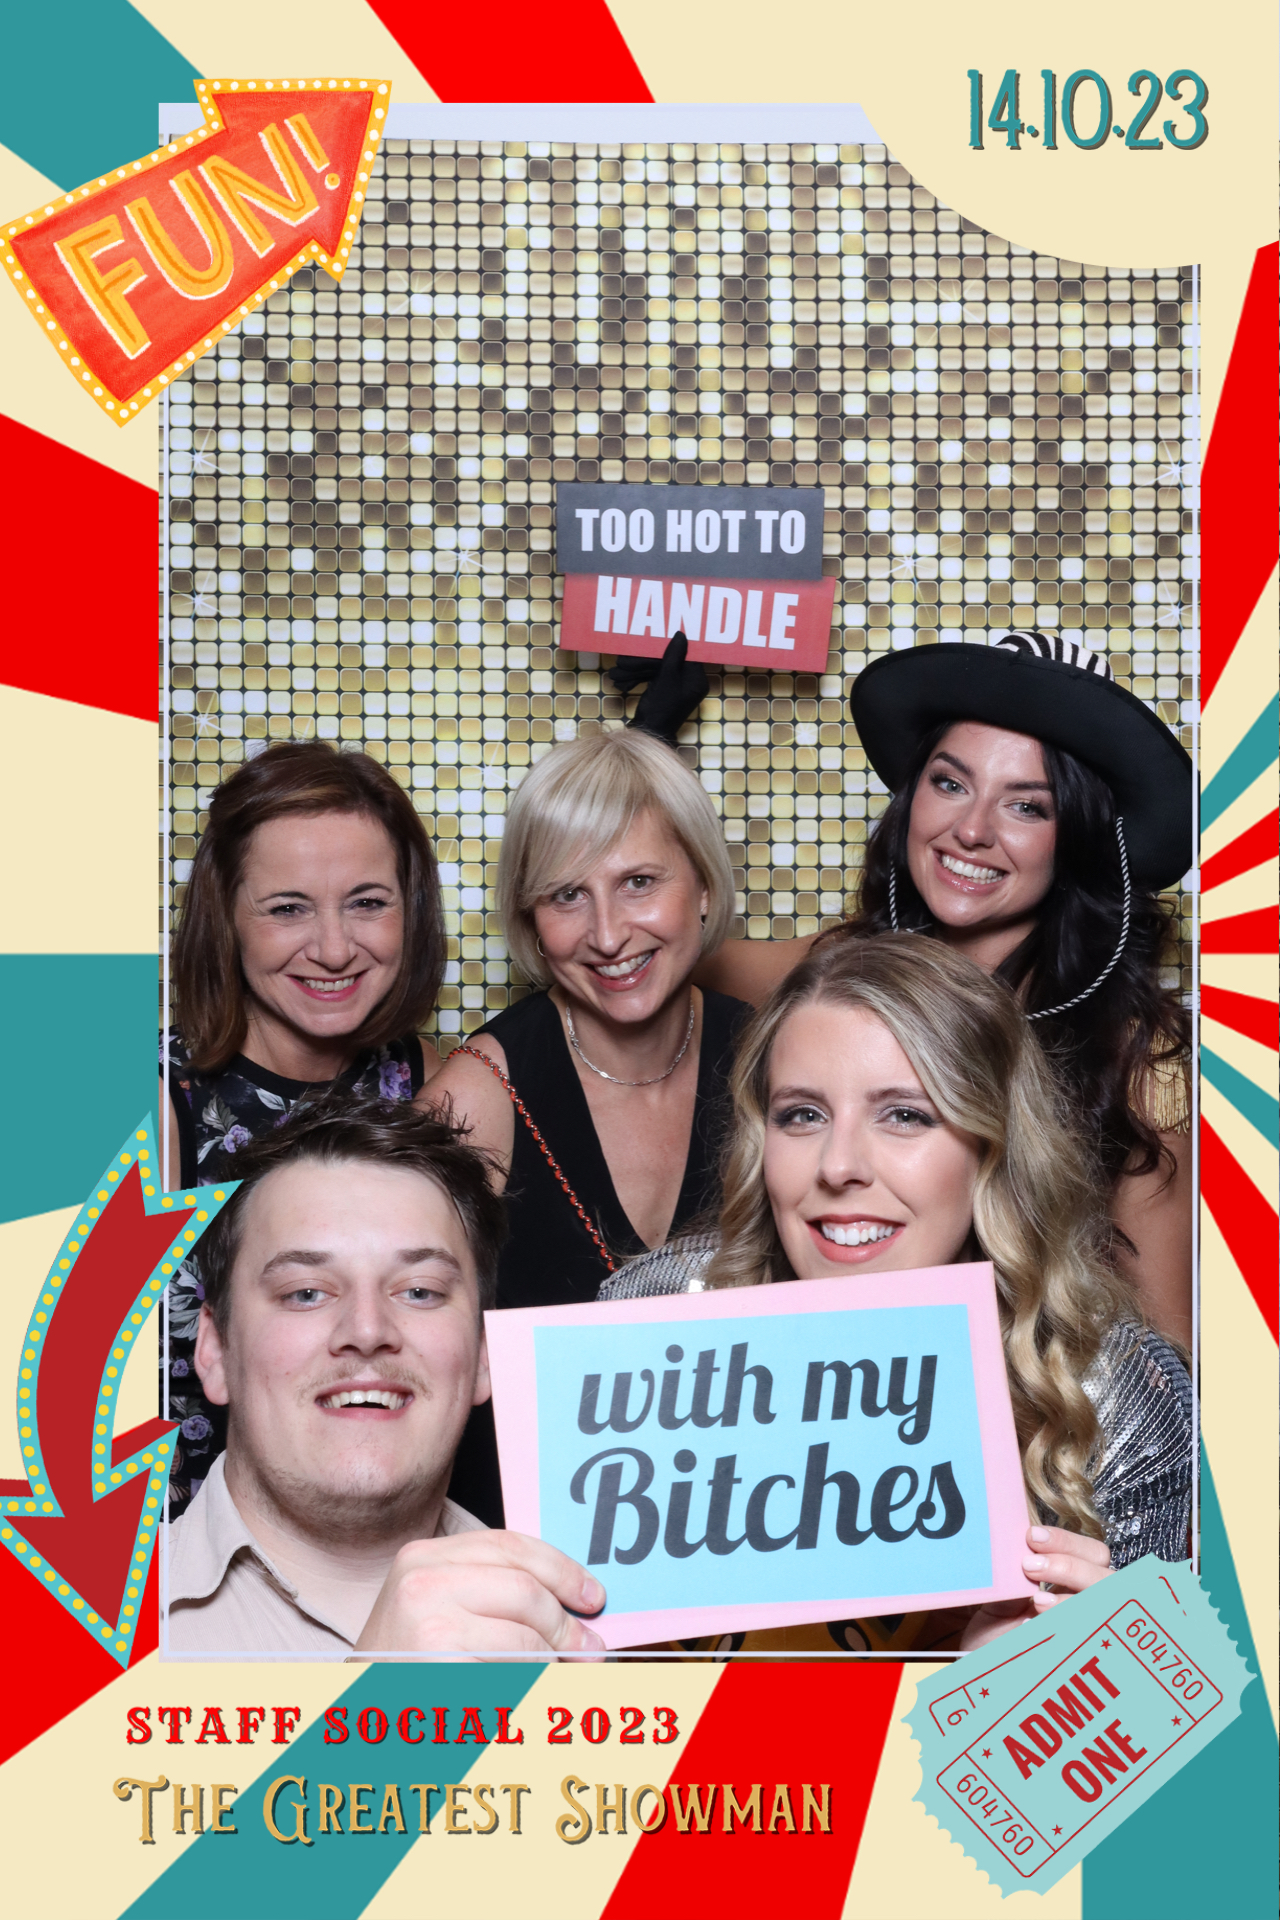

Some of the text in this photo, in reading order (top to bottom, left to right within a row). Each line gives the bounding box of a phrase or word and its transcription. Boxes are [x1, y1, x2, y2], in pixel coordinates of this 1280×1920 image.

[575, 508, 806, 554] TOO HOT TO
[594, 575, 799, 650] HANDLE
[577, 1342, 938, 1445] with my
[569, 1442, 966, 1566] Bitches
